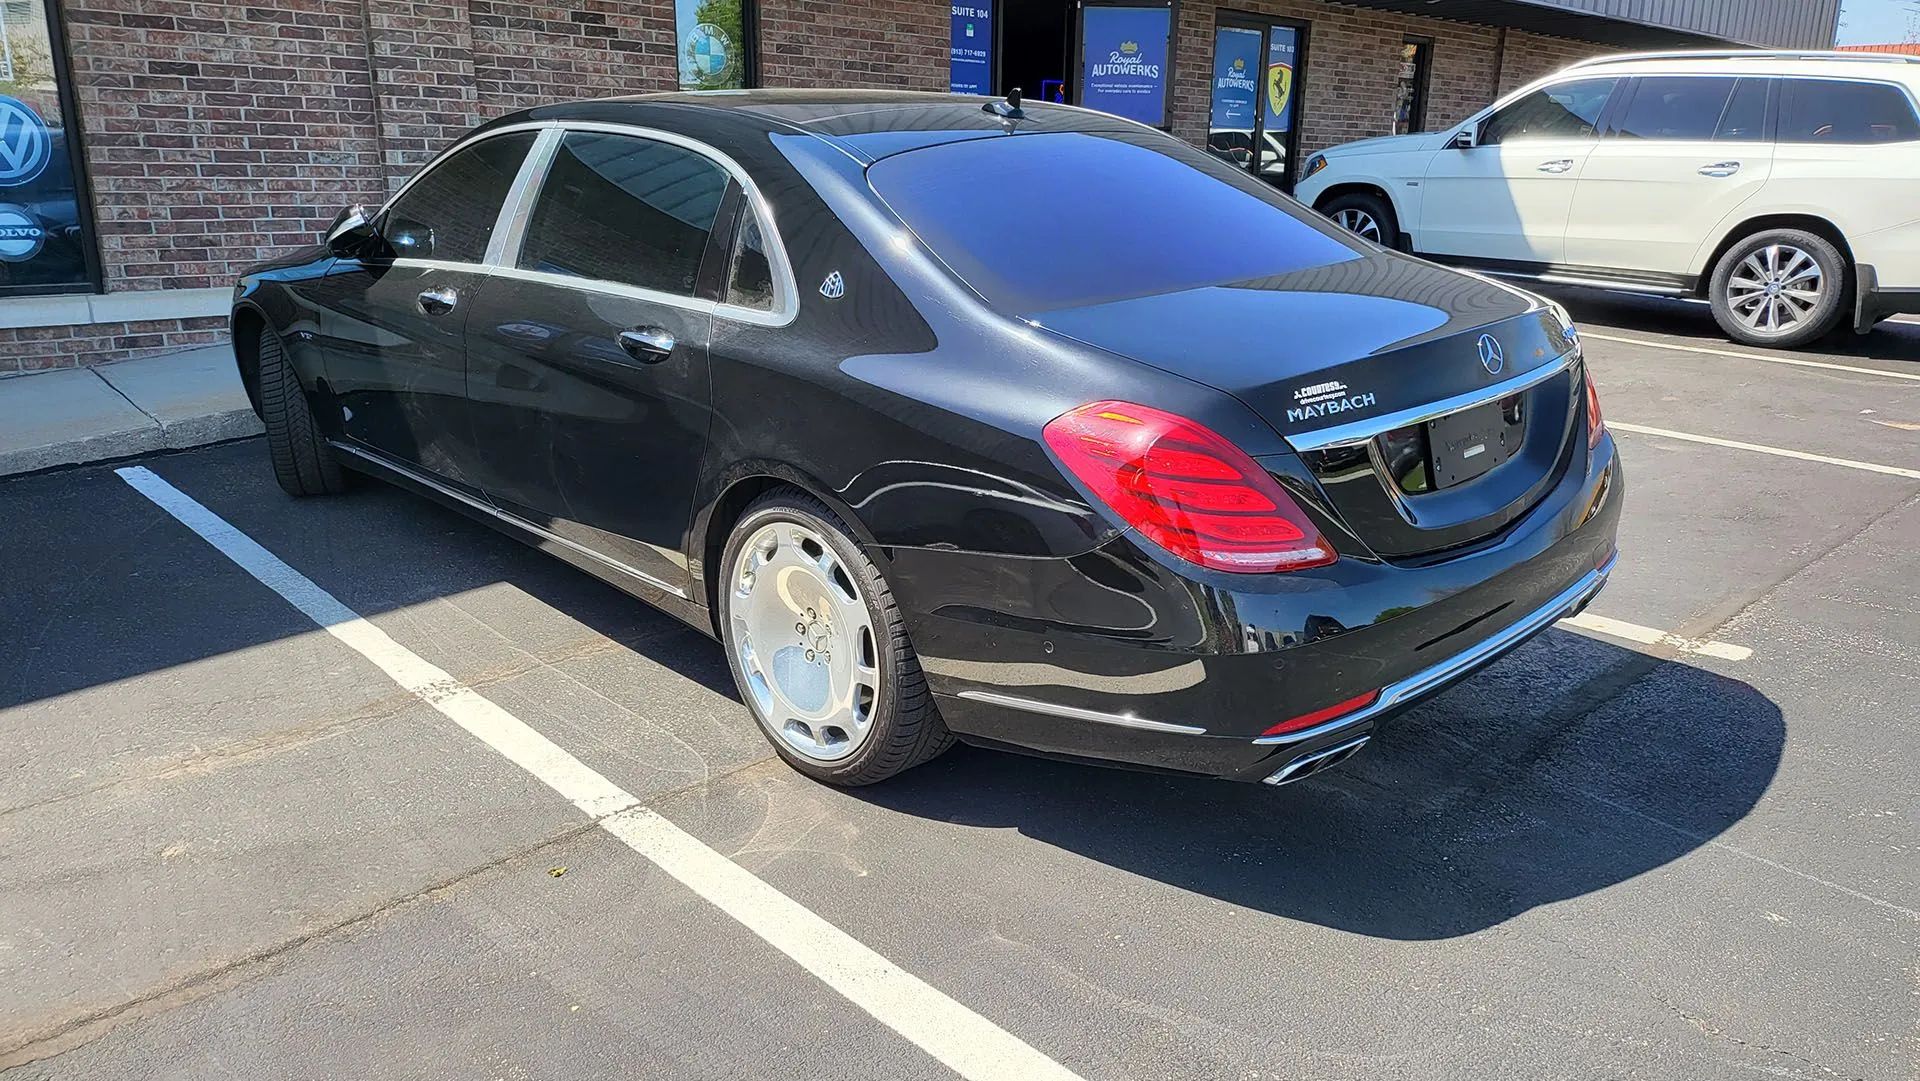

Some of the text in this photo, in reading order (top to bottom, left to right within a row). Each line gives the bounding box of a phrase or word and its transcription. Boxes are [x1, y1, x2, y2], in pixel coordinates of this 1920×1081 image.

[952, 6, 988, 19] SUITE 104
[1270, 43, 1286, 52] SUITE
[1109, 51, 1143, 66] Royal
[1091, 63, 1159, 79] AUTOWERKS
[1227, 66, 1246, 79] Royal
[1217, 77, 1255, 92] AUTOWERKS
[0, 228, 41, 237] OLVO
[1286, 393, 1376, 422] MAYBACH
